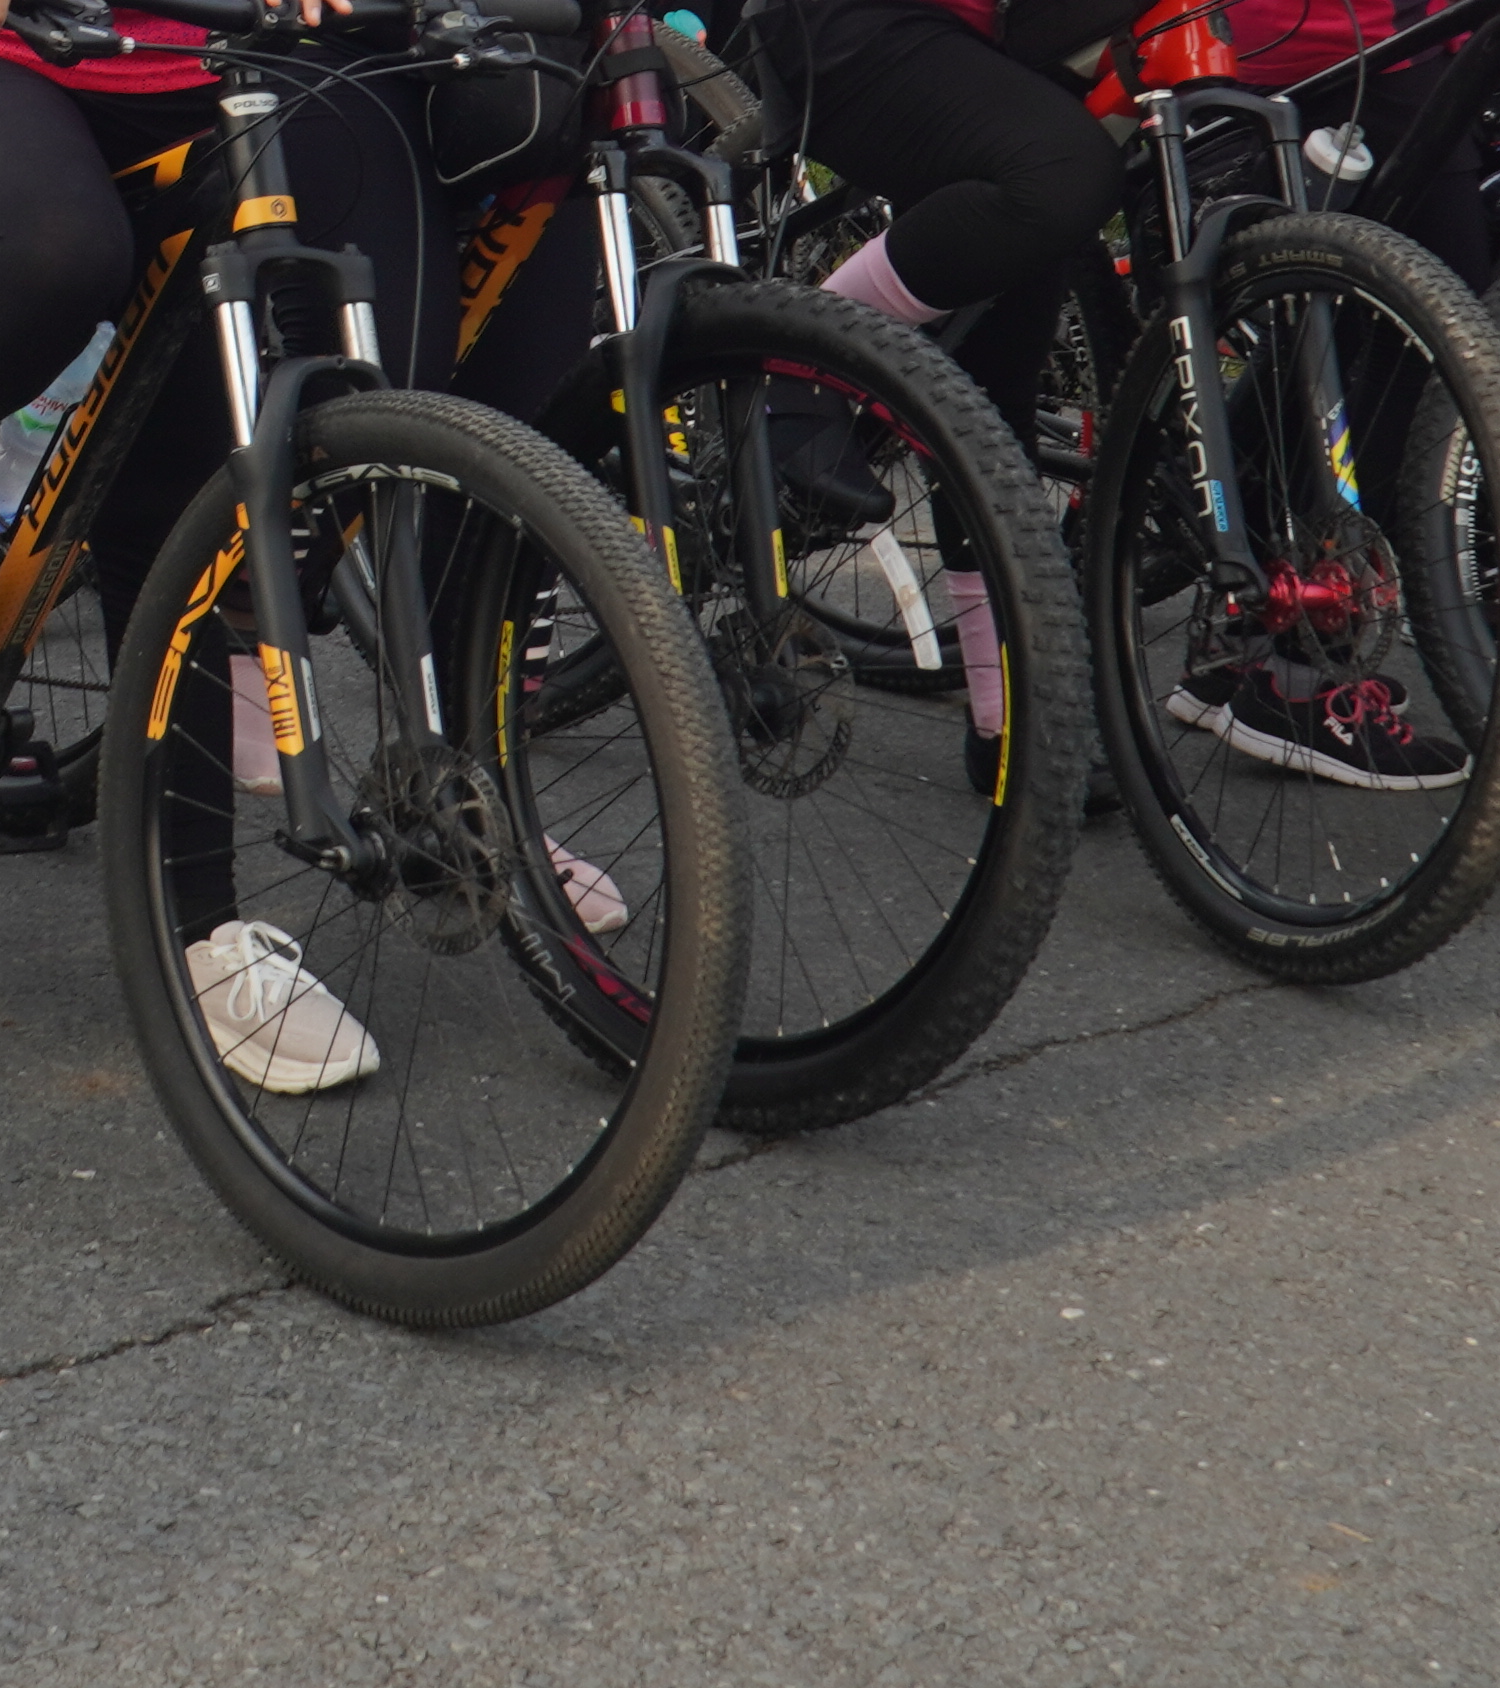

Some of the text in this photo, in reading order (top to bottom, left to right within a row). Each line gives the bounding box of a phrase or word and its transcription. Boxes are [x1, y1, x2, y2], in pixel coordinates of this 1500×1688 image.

[233, 97, 277, 112] POLYG
[1258, 248, 1346, 270] SMART
[1322, 715, 1354, 746] FILA
